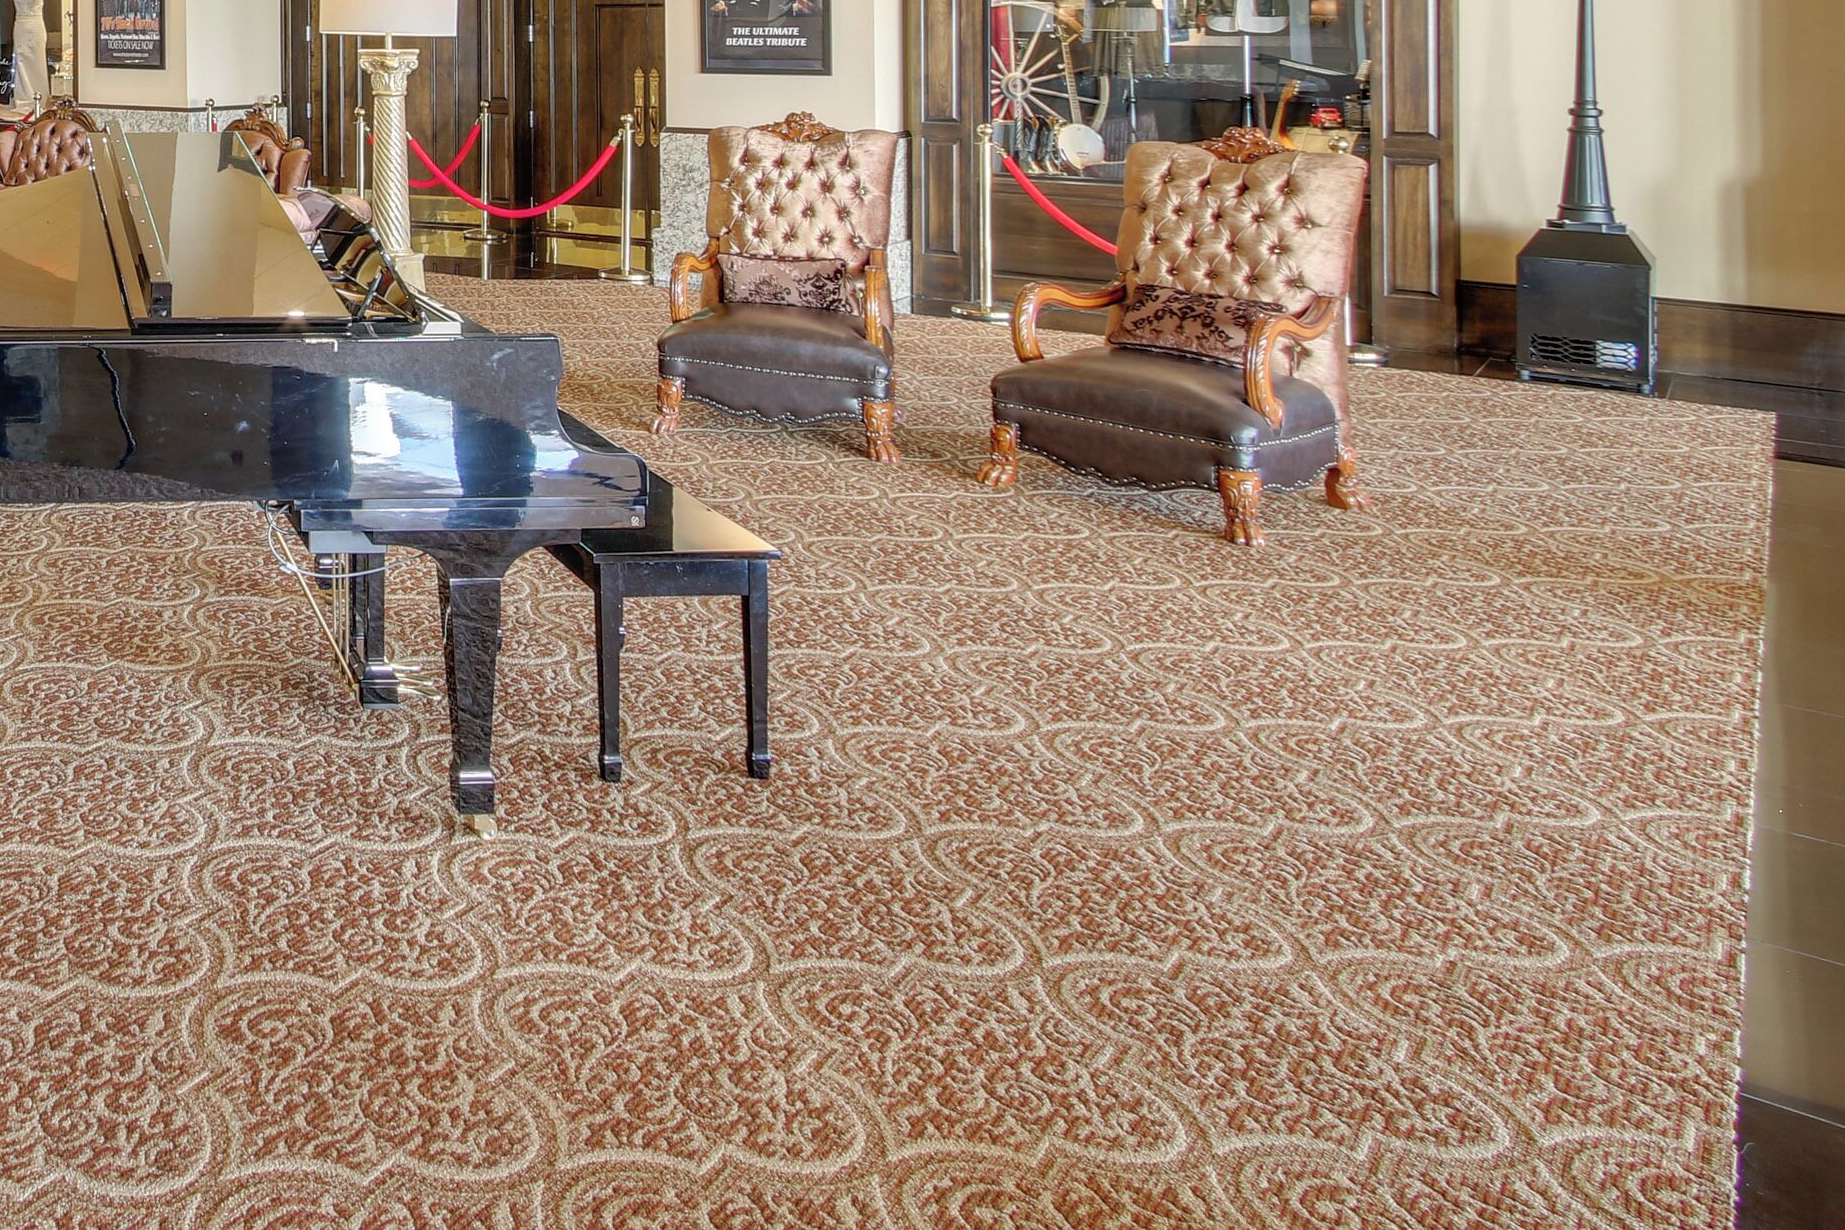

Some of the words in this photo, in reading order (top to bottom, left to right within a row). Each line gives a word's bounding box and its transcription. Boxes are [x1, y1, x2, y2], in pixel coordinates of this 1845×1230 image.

[732, 27, 751, 35] THE
[752, 27, 800, 35] ULTIMATE
[725, 37, 764, 46] BEATLES
[766, 37, 808, 46] TRIBUTE
